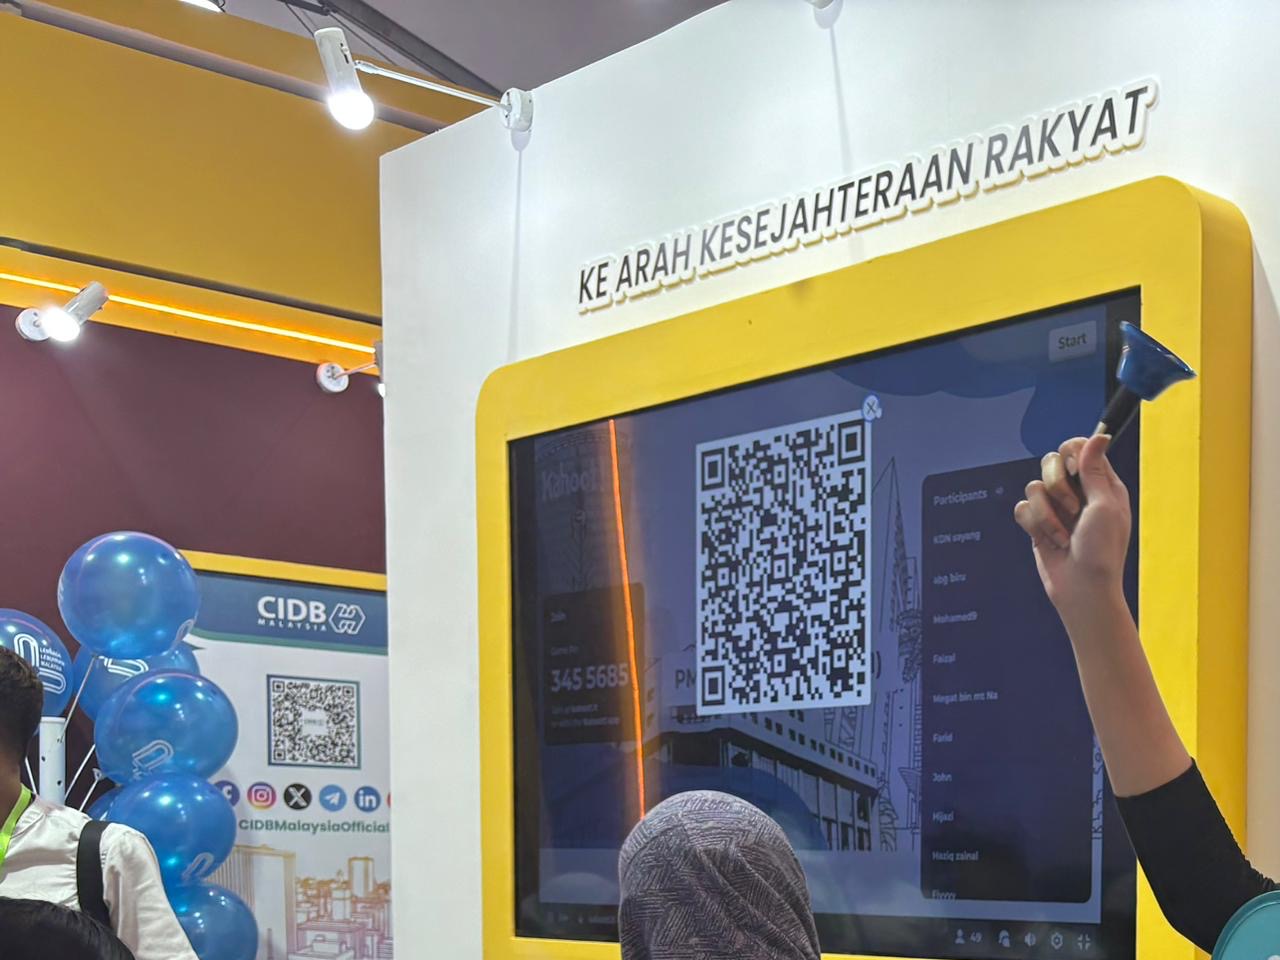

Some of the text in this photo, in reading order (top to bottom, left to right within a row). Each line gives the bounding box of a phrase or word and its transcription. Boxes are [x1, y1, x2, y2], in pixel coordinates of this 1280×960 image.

[579, 85, 1150, 304] KE ARAH KESEJAHTERAAN RAKYAT
[1058, 333, 1088, 350] Start
[933, 488, 988, 506] Participants
[257, 595, 326, 623] CIDB
[258, 618, 327, 632] MALAYSIA
[551, 663, 629, 692] 345 5685
[239, 819, 390, 835] CIDBMalaysiaOfficial
